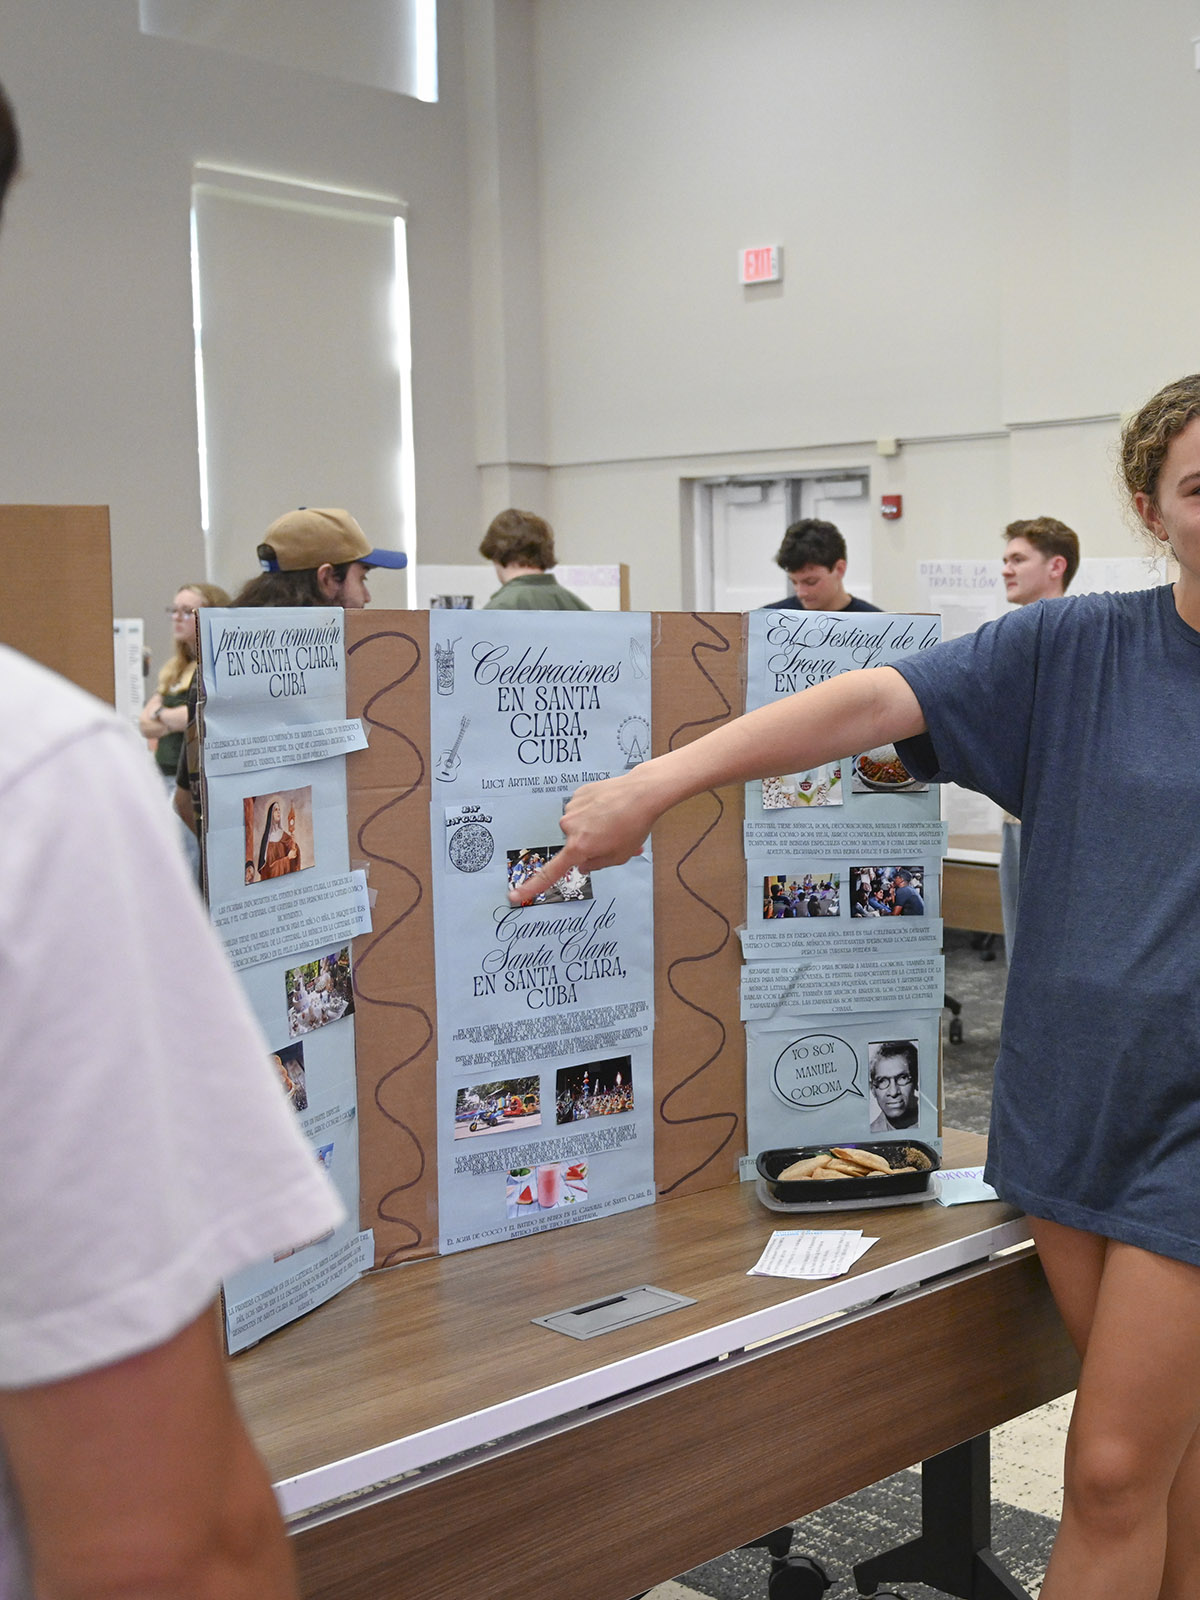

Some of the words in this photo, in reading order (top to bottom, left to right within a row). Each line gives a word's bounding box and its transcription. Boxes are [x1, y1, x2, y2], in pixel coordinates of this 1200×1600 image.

[744, 248, 772, 281] EXIT
[214, 626, 276, 666] primera
[281, 618, 341, 648] comunión
[804, 614, 894, 649] Festival
[890, 622, 914, 650] de
[918, 623, 940, 650] la
[227, 651, 246, 677] EN
[250, 648, 291, 675] SANTA
[295, 645, 339, 671] CLARA,
[471, 641, 622, 685] Celebraciones
[767, 643, 837, 674] Trova
[269, 672, 307, 698] CUBA
[775, 674, 797, 692] EN
[498, 687, 524, 712] EN
[535, 686, 601, 711] SANTA
[510, 712, 588, 740] CLARA,
[517, 738, 582, 764] CUBA
[493, 900, 597, 942] Carnaval
[593, 898, 616, 930] de
[482, 937, 553, 974] Santa
[558, 929, 618, 963] Clara
[473, 974, 496, 997] EN
[504, 965, 558, 992] SANTA
[565, 957, 627, 983] CLARA,
[526, 983, 578, 1009] CUBA
[791, 1046, 809, 1060] YO
[813, 1042, 835, 1056] SOY
[795, 1062, 837, 1080] MANUEL
[791, 1080, 842, 1100] CORONA
